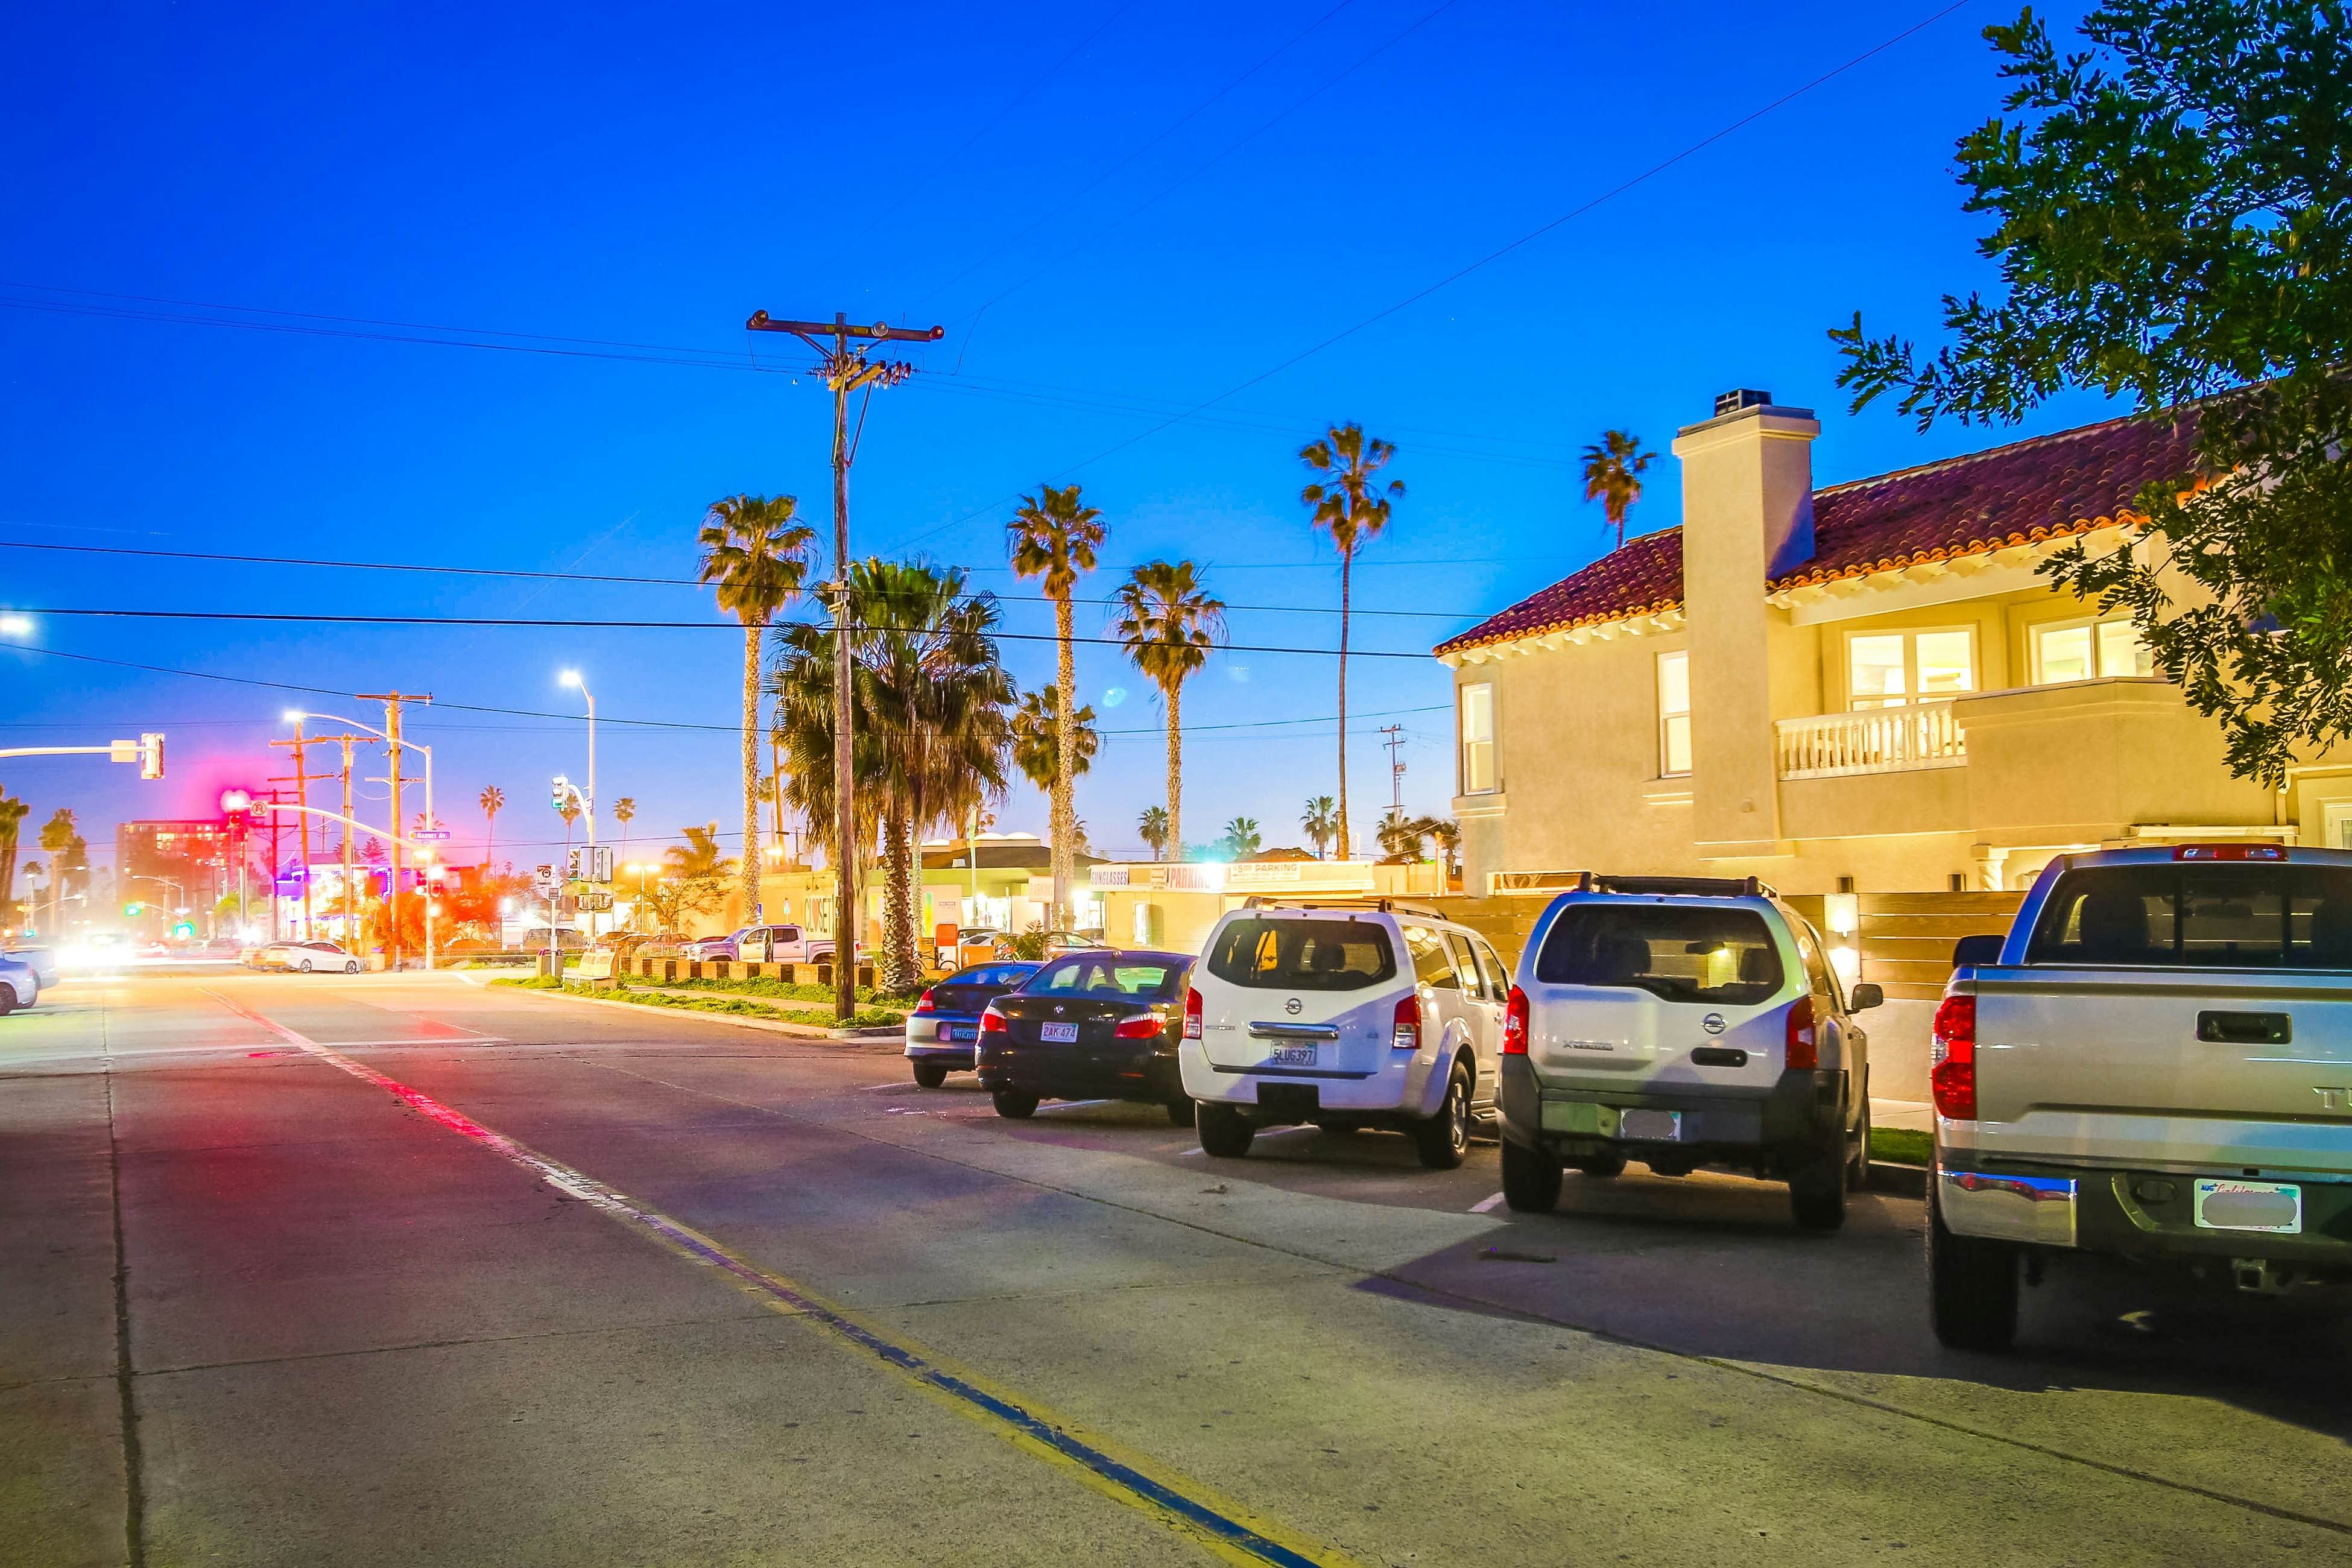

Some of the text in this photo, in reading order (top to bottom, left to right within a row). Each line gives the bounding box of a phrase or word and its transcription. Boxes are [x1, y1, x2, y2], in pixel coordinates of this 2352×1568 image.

[1254, 864, 1297, 872] PARKING
[1090, 871, 1127, 885] SUNGLASSES
[1170, 867, 1210, 888] PARKIN
[1274, 1049, 1313, 1062] 5LUG397
